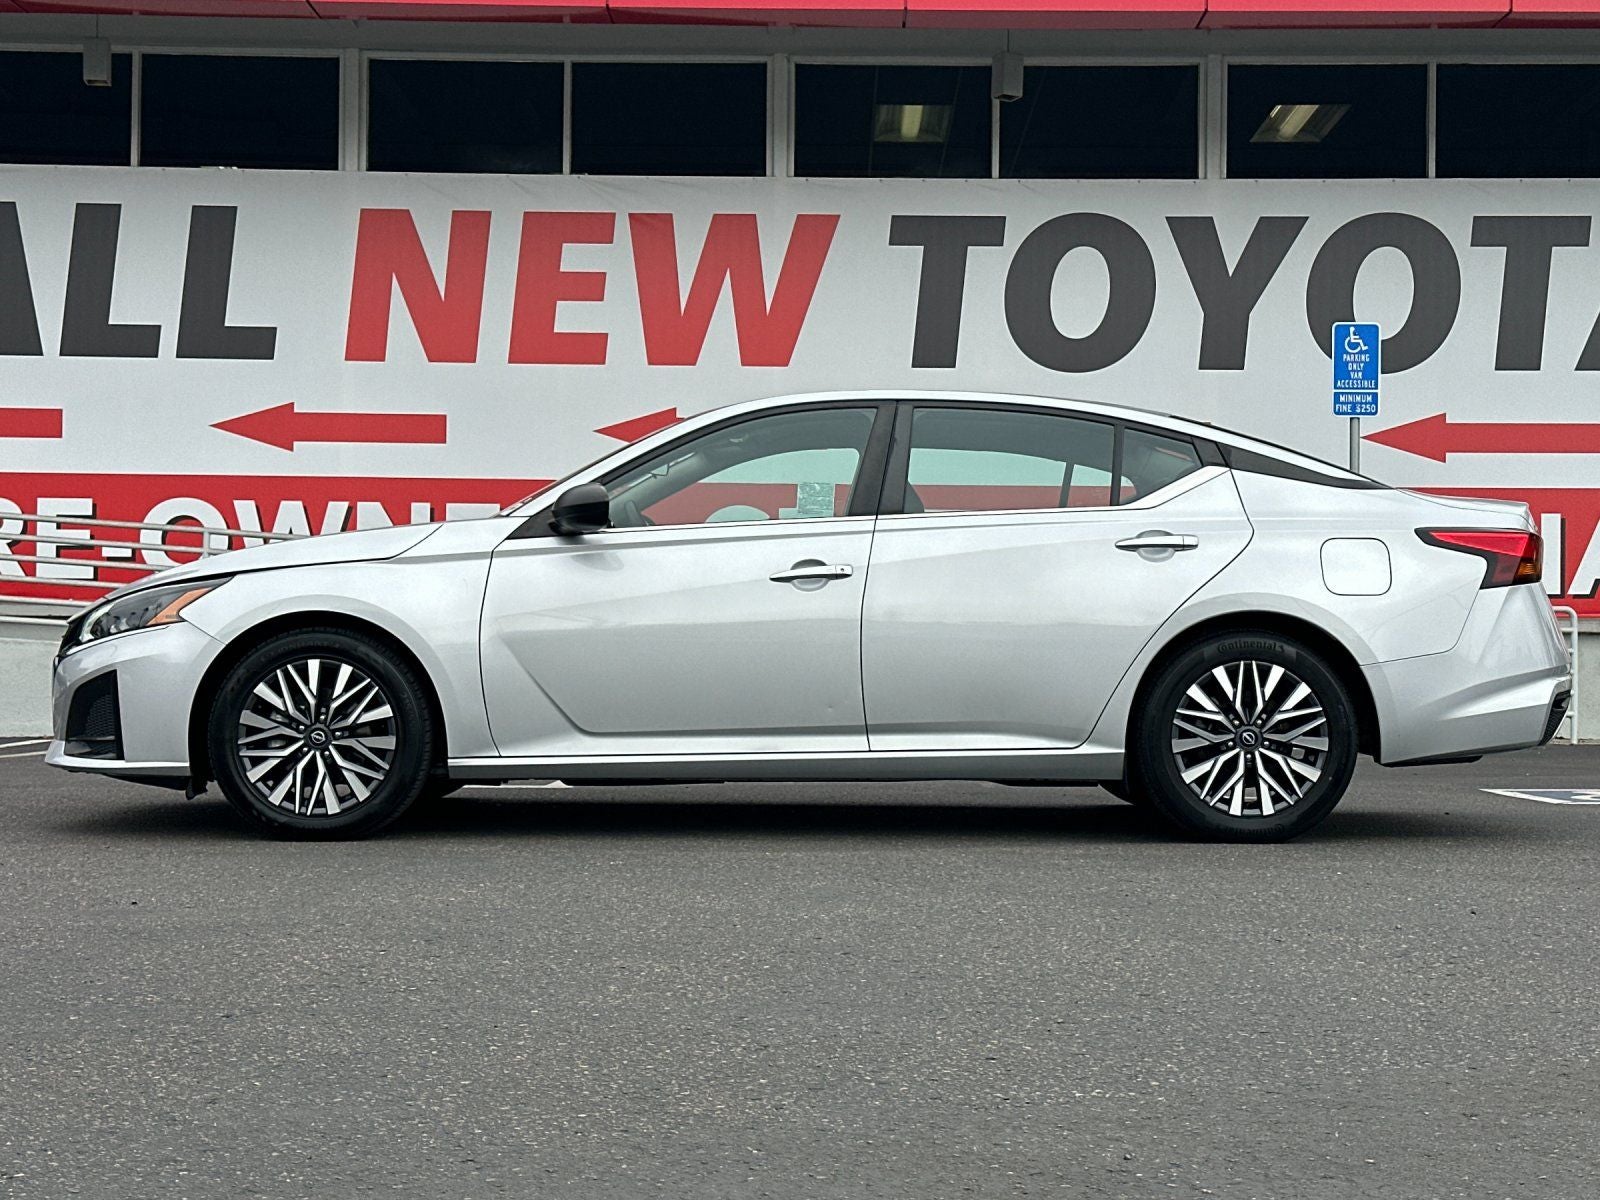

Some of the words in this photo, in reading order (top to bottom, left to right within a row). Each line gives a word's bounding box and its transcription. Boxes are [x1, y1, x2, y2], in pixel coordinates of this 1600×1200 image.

[345, 208, 841, 367] NEW
[889, 212, 1600, 374] TOYOT
[1343, 354, 1370, 362] PARKING
[1348, 363, 1365, 371] ONLY
[1337, 380, 1375, 388] ACCESSIBLE
[1340, 394, 1372, 402] MINIMUM
[1335, 404, 1352, 412] FINE
[1356, 404, 1376, 413] $250
